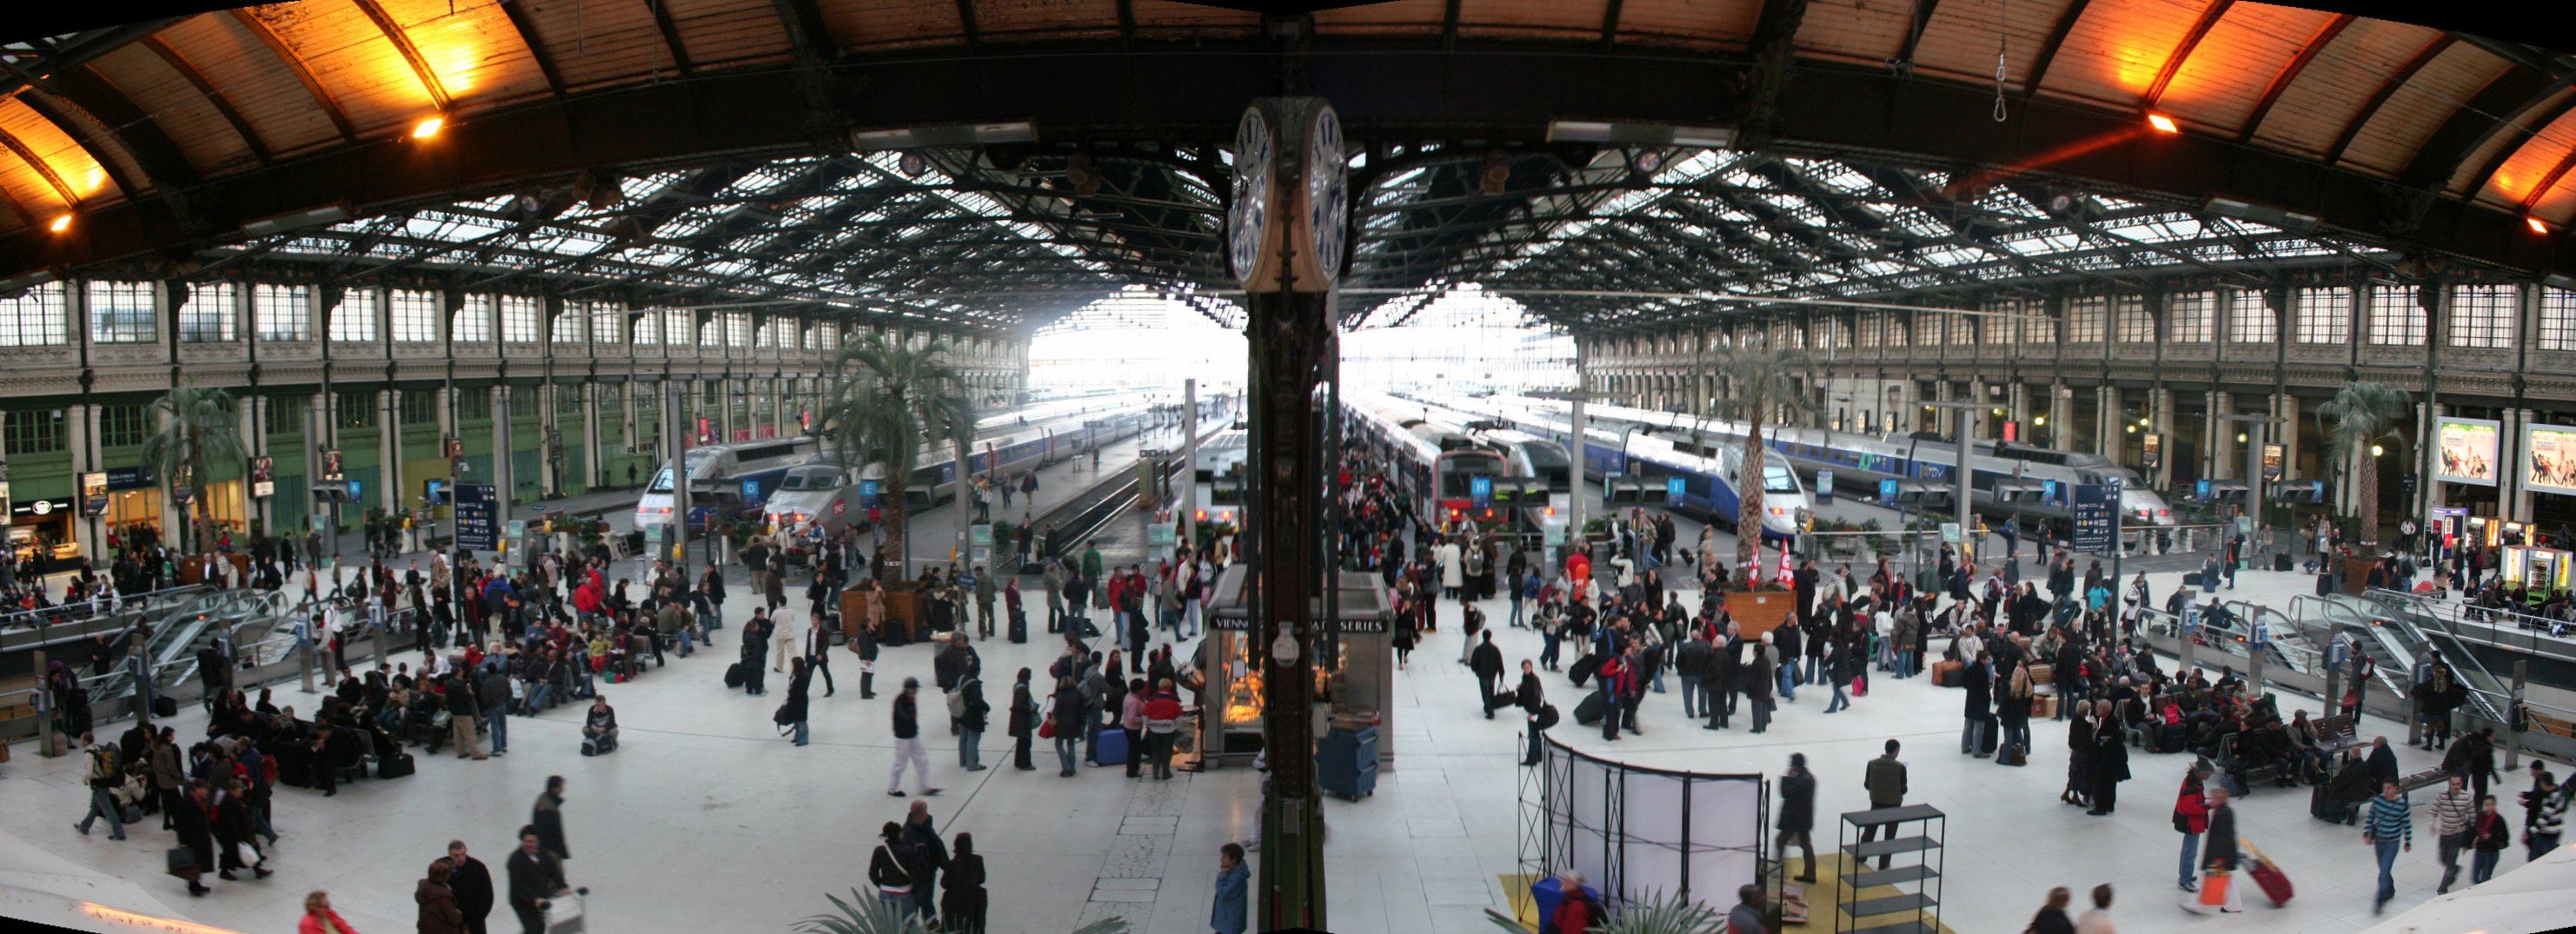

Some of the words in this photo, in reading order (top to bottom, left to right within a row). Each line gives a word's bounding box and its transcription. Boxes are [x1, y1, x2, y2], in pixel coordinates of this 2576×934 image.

[1929, 467, 1943, 478] TGV
[747, 484, 754, 493] D
[866, 484, 872, 493] E
[1477, 481, 1484, 492] H
[1886, 483, 1891, 492] J
